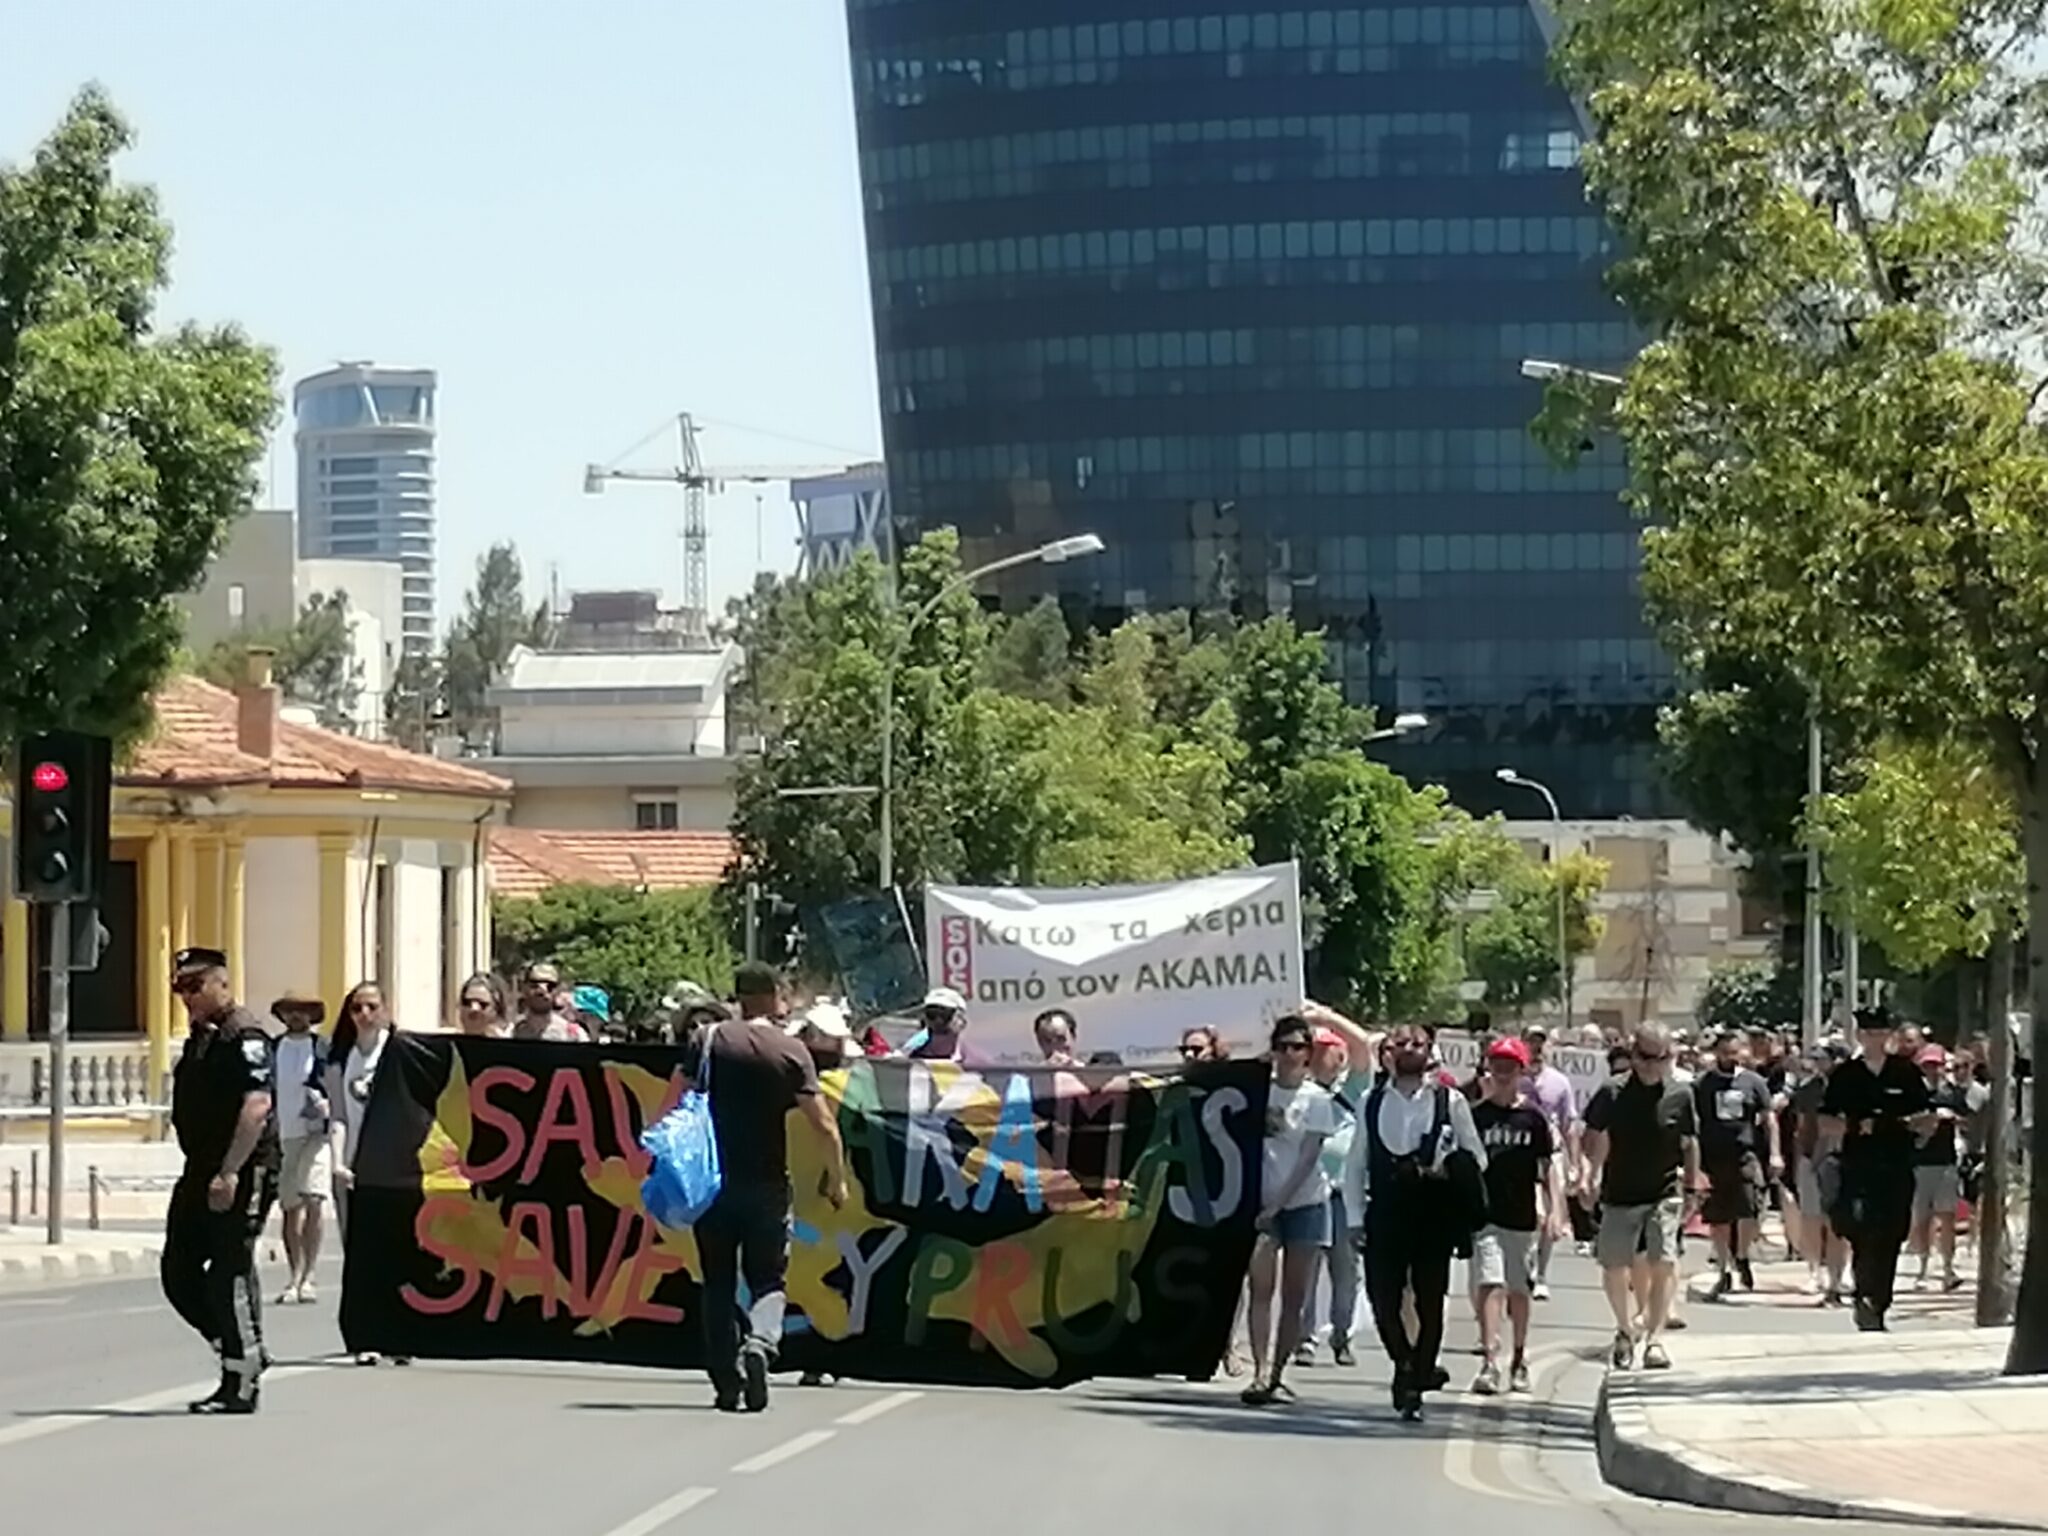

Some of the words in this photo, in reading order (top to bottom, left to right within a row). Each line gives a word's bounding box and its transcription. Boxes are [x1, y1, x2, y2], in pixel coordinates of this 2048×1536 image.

[946, 917, 970, 999] SOS
[1109, 920, 1148, 942] τα
[978, 969, 1045, 1002] από
[1058, 973, 1119, 999] τον
[1135, 952, 1288, 992] ΑΚΑΜΑ!
[443, 1065, 688, 1184] SAV
